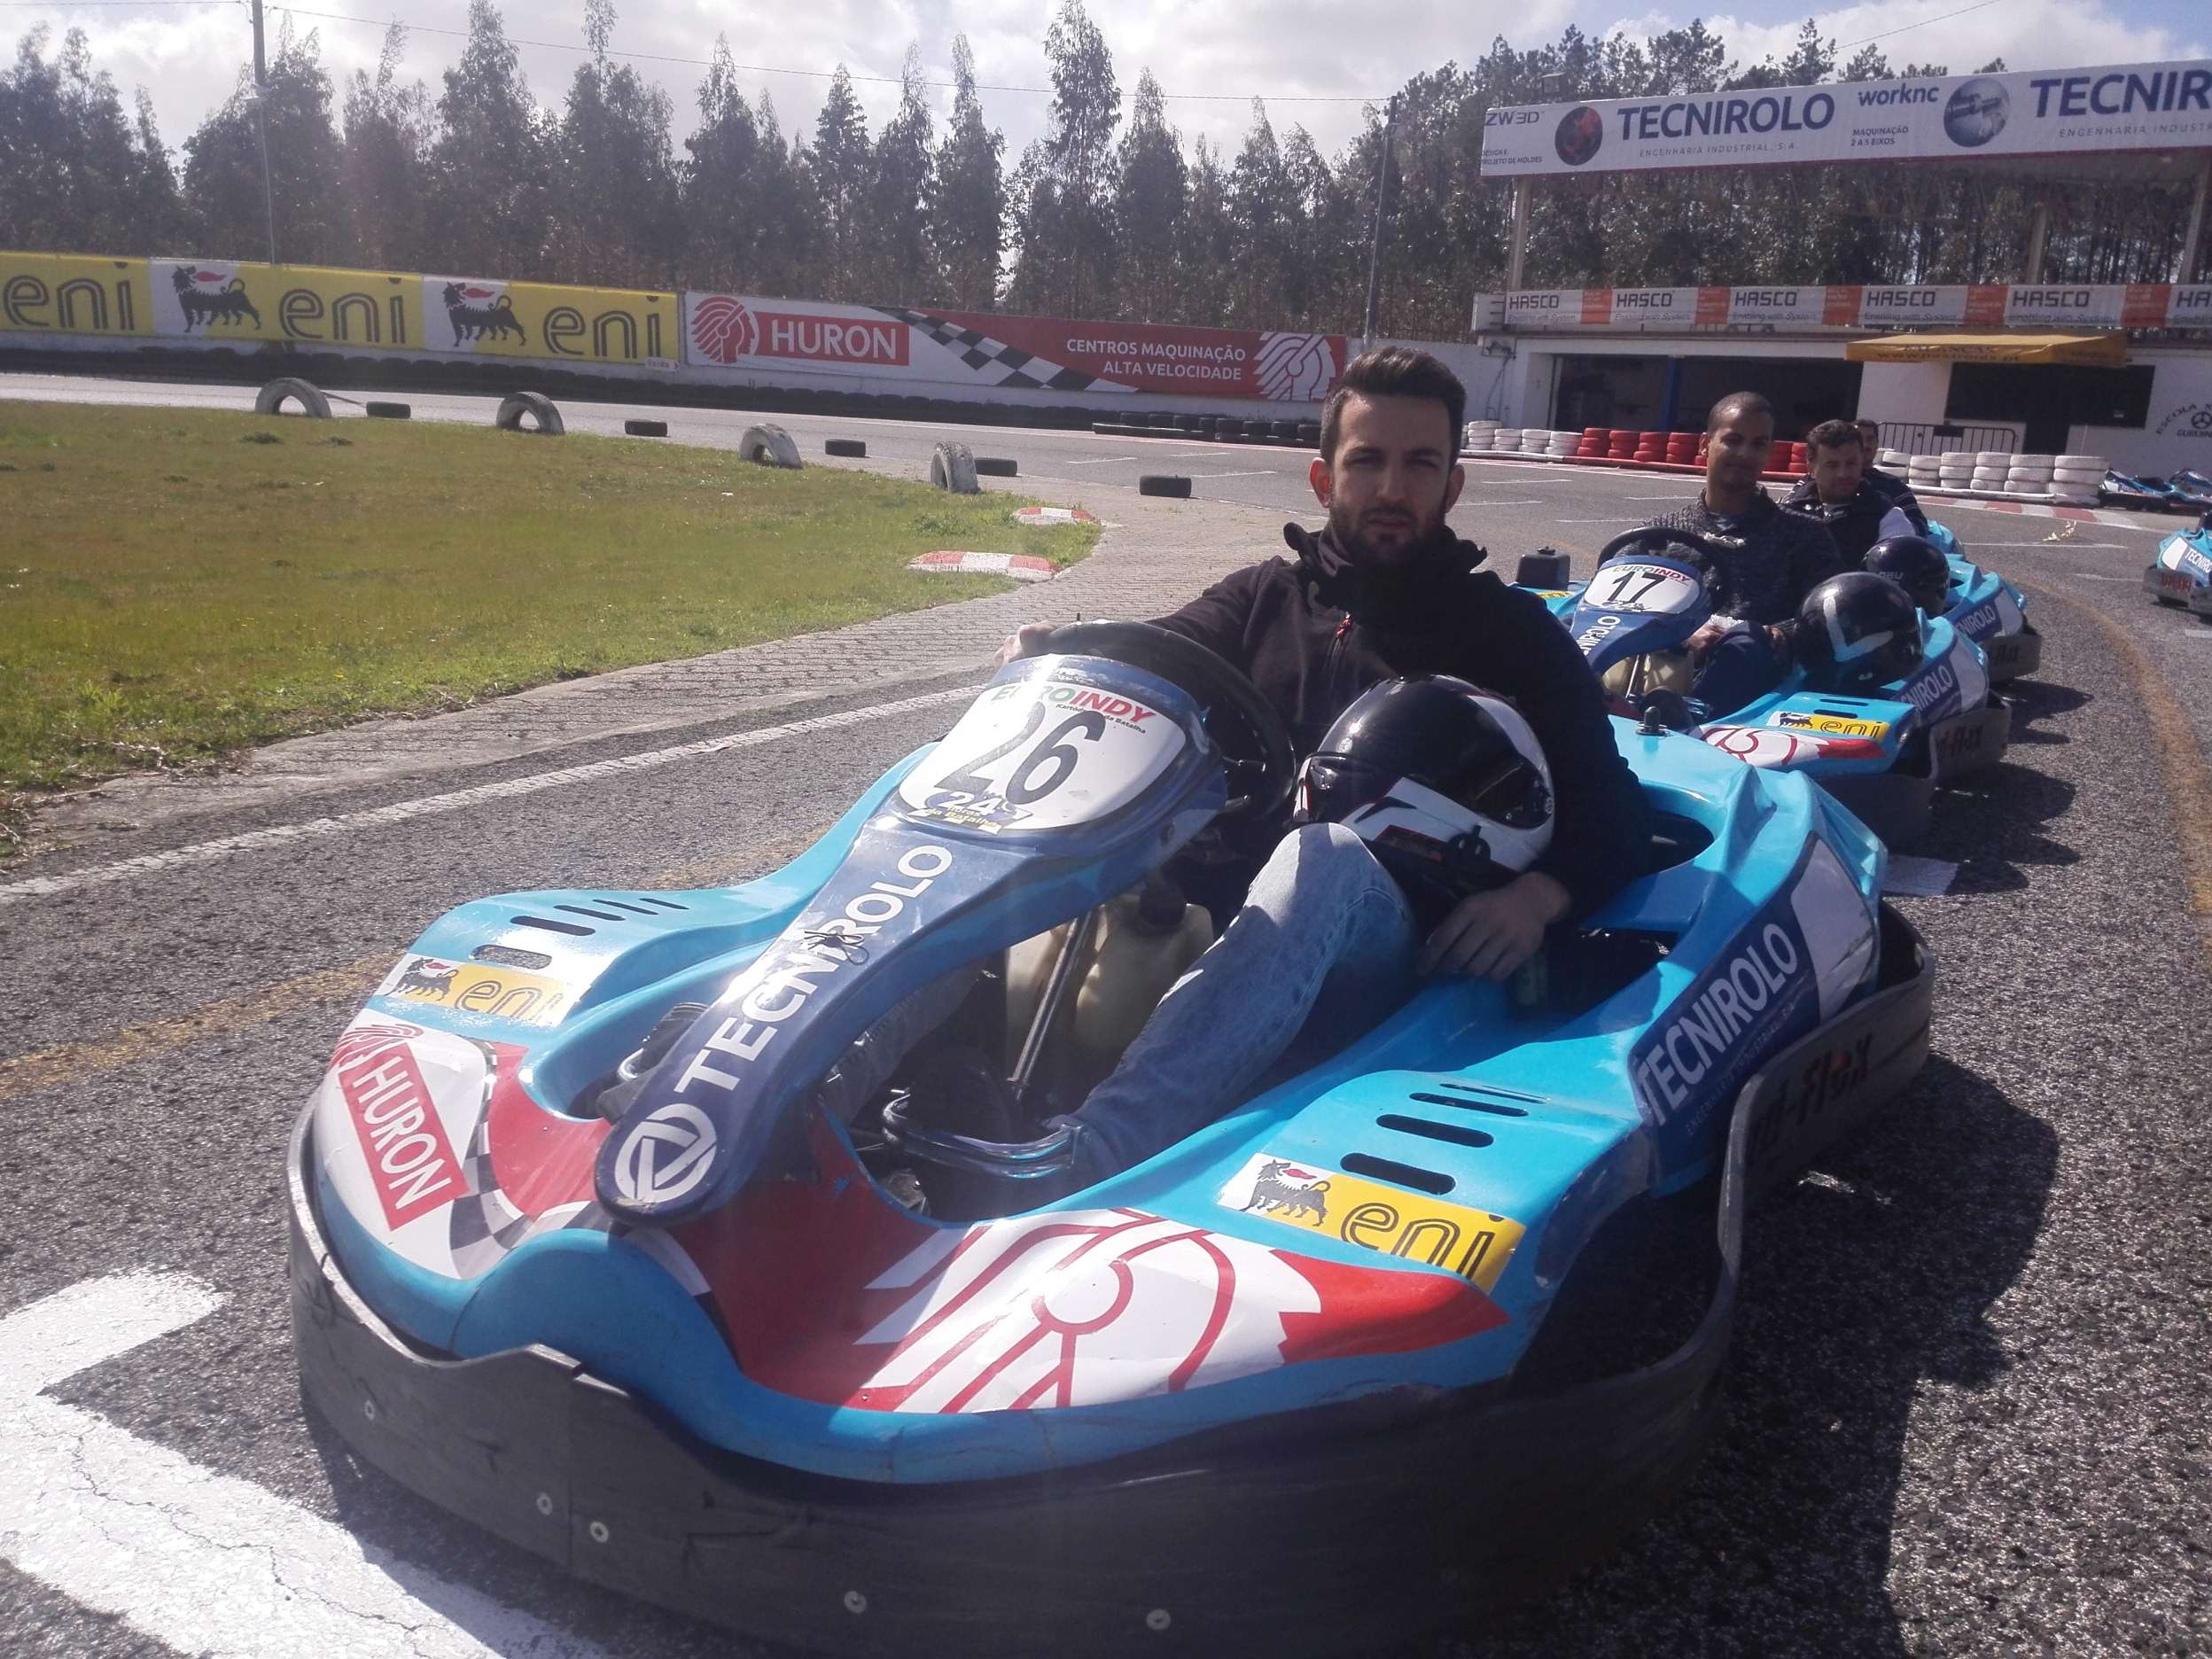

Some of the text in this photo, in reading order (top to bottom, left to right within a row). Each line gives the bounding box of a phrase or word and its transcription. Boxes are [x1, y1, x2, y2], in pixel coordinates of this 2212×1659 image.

[1485, 112, 1540, 126] ZW3D
[1617, 92, 1834, 140] TECNIROLO
[1852, 125, 1909, 136] MAQUINAÇÃO
[2060, 126, 2146, 138] ENGENHARIA
[1639, 148, 1702, 158] ENGENHARIA
[4, 261, 136, 331] eni
[1509, 294, 1559, 309] HASCO
[1616, 293, 1672, 308] HASCO
[1734, 291, 1798, 307] HASCO
[1866, 291, 1936, 307] HASCO
[2012, 291, 2091, 308] HASCO
[2177, 291, 2212, 308] HA
[278, 277, 407, 345] eni
[542, 295, 662, 359] eni
[770, 319, 897, 361] HURON
[1066, 339, 1246, 362] CENTROS MAQUINAÇÃO
[1103, 360, 1242, 381] ALTA VELOCIDADE
[1613, 565, 1692, 581] EUROINDY
[1608, 572, 1669, 604] 17
[1576, 616, 1621, 656] NIROLO
[992, 685, 1157, 722] EOINDY
[1116, 719, 1147, 735] Batalha
[1819, 720, 1883, 738] eni
[934, 699, 1106, 806] 26
[938, 791, 1003, 815] 24
[674, 845, 953, 1093] TECNIROLO
[454, 980, 564, 1021] eni
[1637, 923, 1797, 1126] TECNIROLO
[352, 1055, 453, 1211] HURON
[1341, 1203, 1504, 1281] eni
